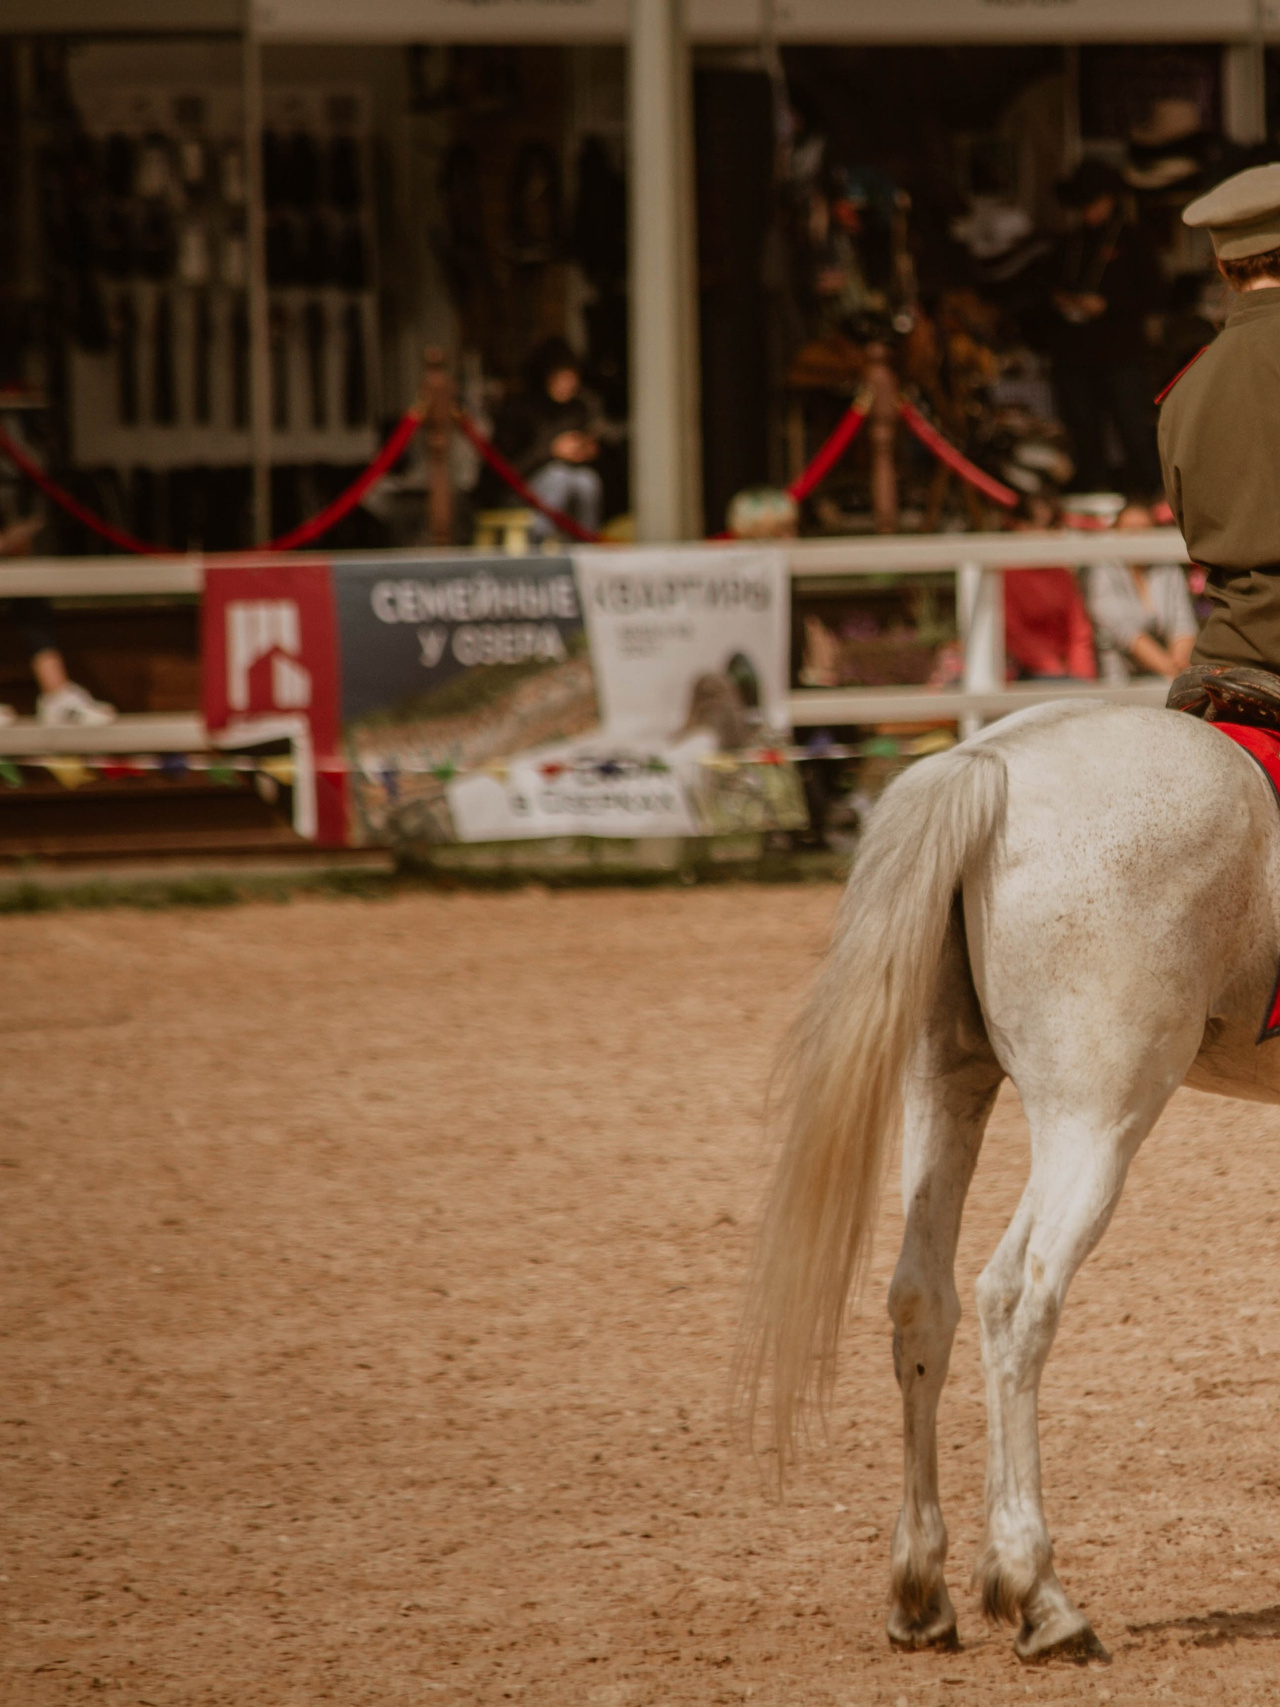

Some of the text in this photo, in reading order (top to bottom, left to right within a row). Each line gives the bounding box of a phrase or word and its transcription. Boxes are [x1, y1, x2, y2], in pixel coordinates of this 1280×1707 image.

[371, 570, 579, 624] СЕМЕЙНЫЕ
[416, 624, 449, 668] У
[452, 622, 568, 667] ОЗЕРА
